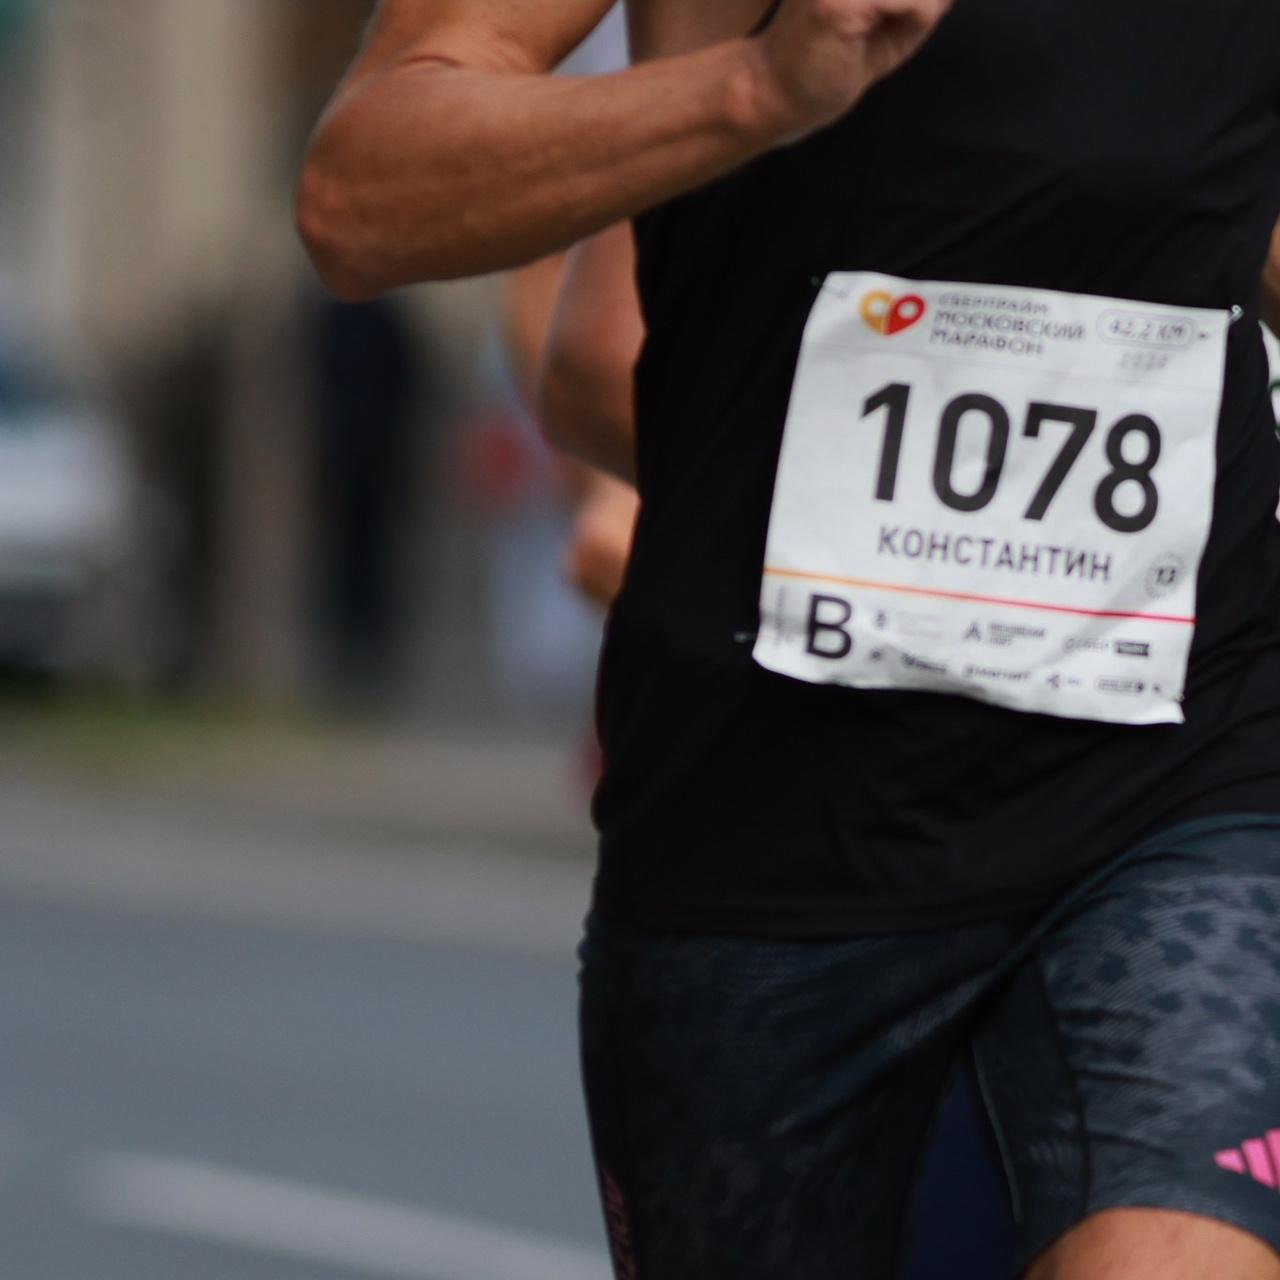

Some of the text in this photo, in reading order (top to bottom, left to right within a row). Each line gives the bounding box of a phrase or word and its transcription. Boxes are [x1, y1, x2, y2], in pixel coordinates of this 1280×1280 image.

[930, 327, 1045, 356] МАРАФОН
[859, 381, 1161, 534] 1078
[877, 524, 1113, 582] КОНСТАНТИН
